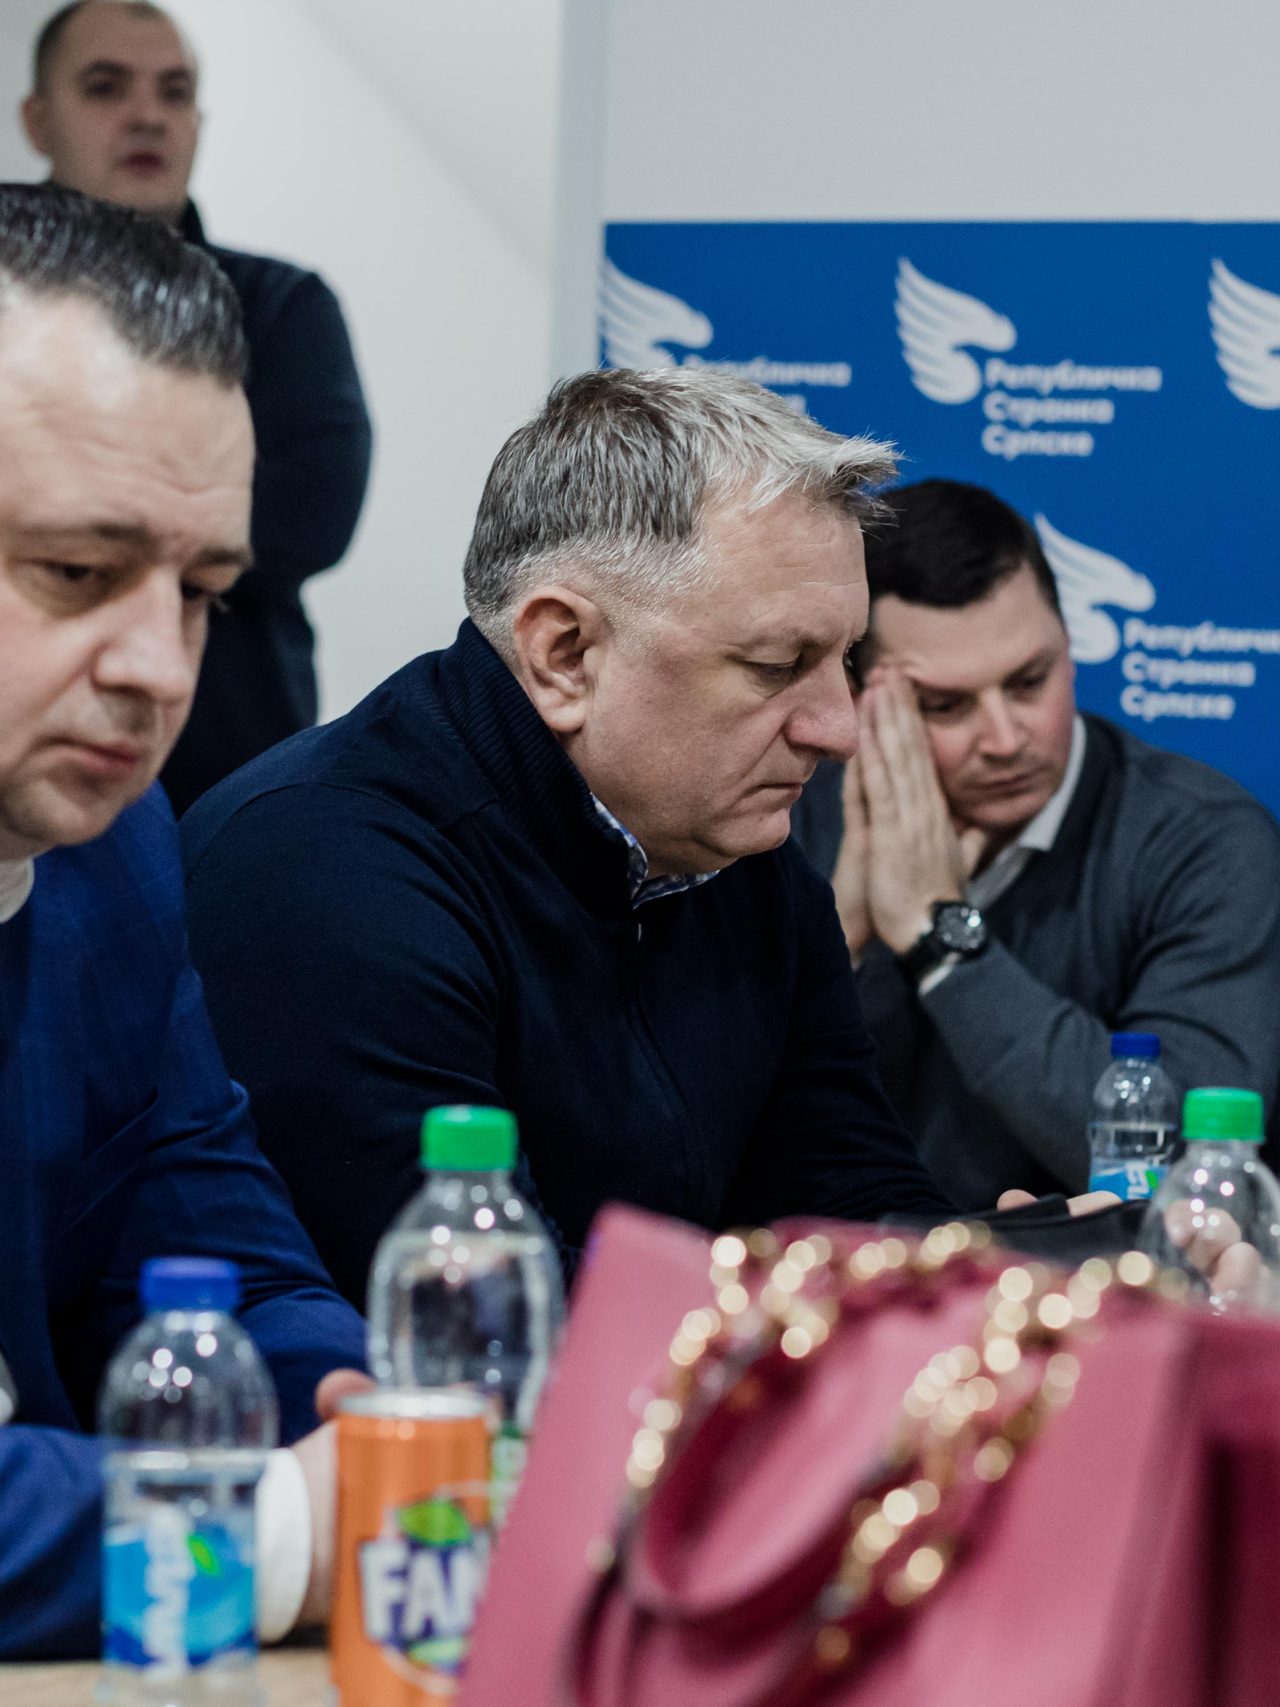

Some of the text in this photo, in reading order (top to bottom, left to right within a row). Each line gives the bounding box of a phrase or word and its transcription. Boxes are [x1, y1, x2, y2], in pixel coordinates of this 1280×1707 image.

[985, 358, 1162, 395] Републичка
[983, 390, 1115, 428] Странка
[982, 423, 1094, 461] Српске
[1122, 651, 1256, 688] Странка
[1121, 683, 1235, 721] Српске
